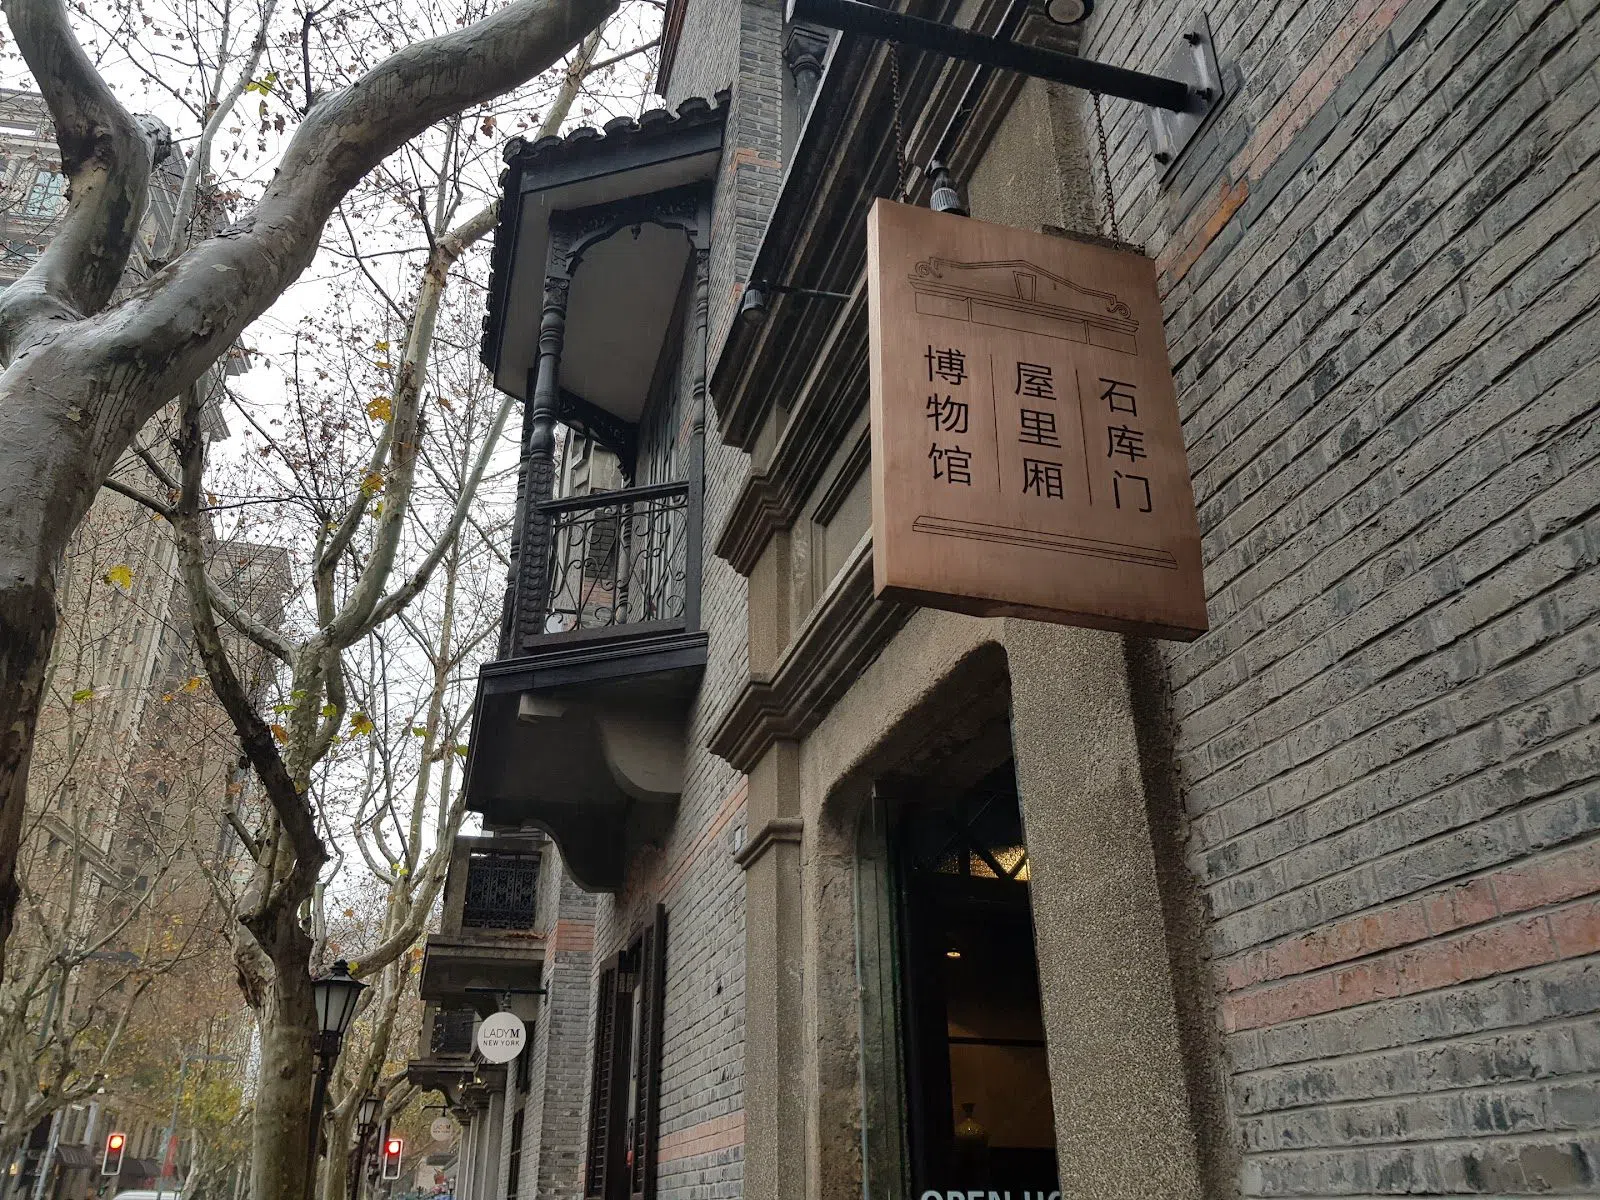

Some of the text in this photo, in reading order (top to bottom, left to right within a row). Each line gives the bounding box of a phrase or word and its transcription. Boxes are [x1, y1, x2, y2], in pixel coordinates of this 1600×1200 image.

[924, 344, 972, 487] 博物馆
[1014, 361, 1064, 501] 屋里厢
[1099, 377, 1153, 513] 石库门
